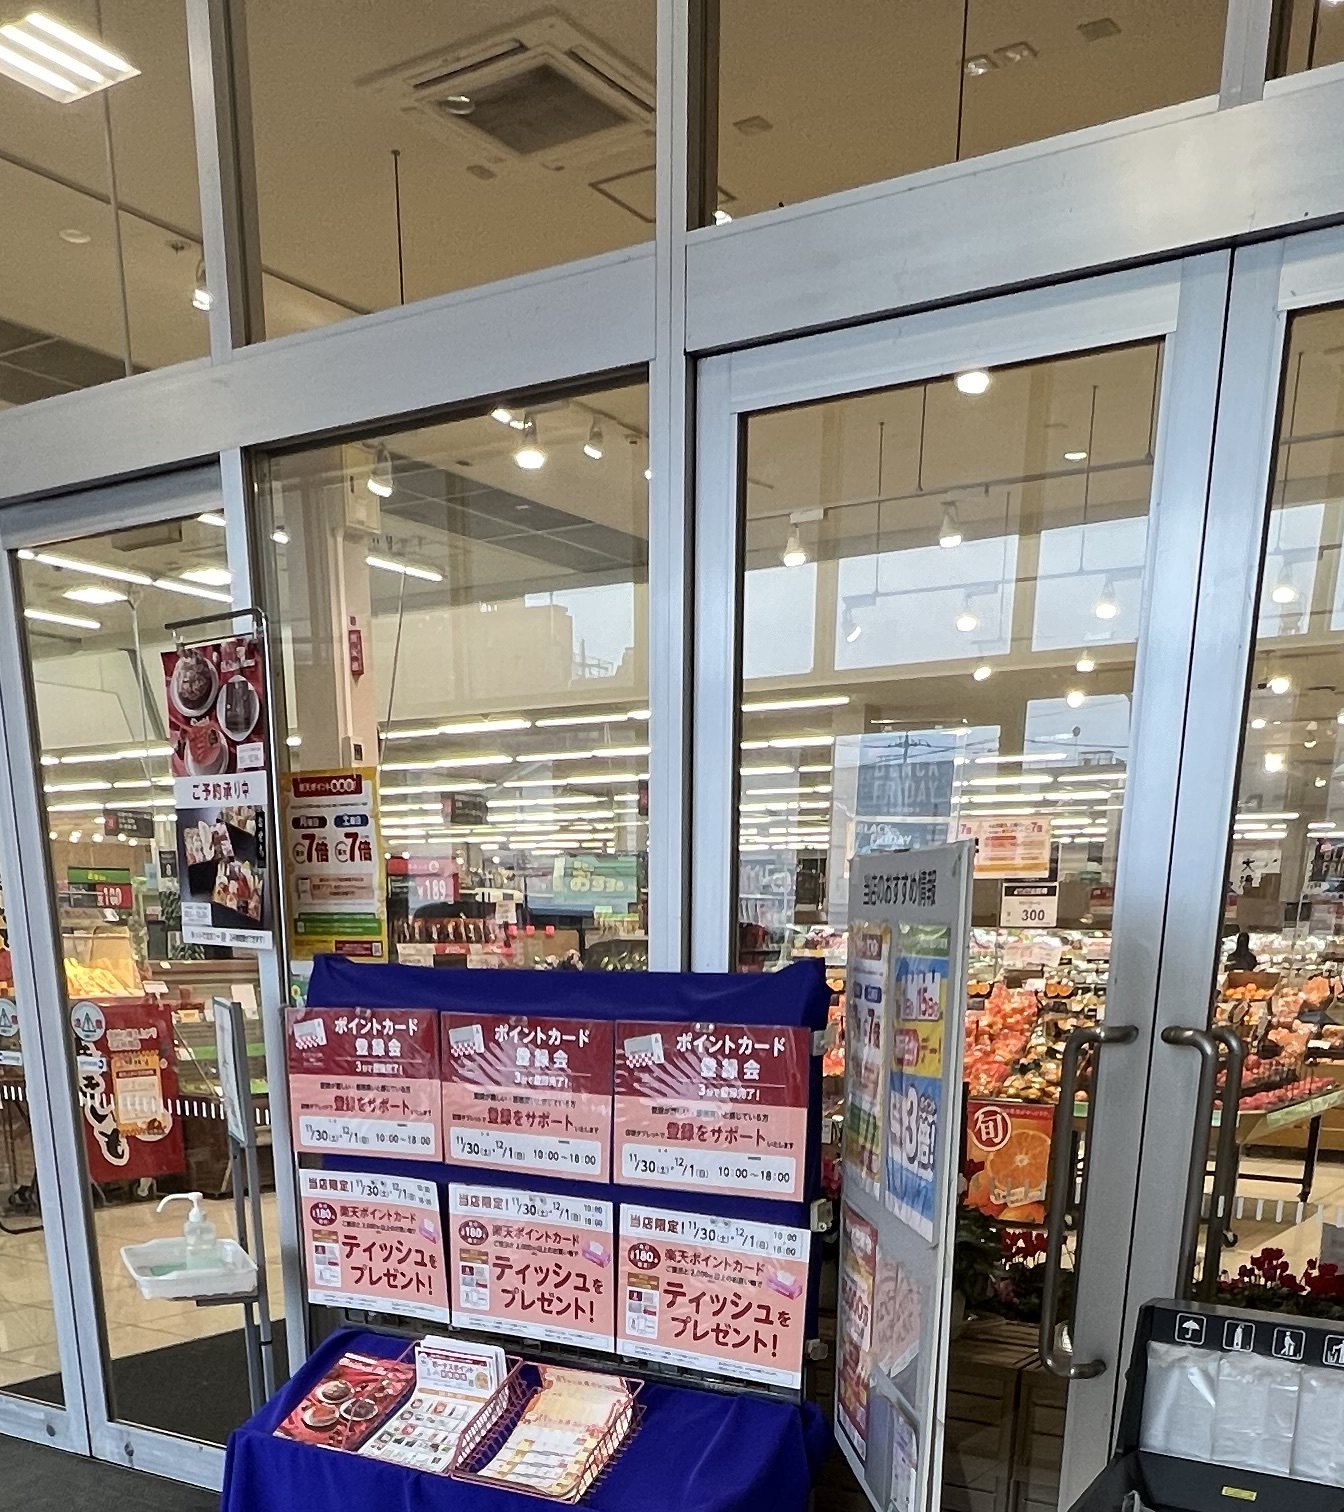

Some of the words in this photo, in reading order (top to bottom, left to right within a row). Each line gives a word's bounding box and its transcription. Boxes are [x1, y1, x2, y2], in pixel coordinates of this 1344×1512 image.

[192, 780, 251, 800] ご予約承り中
[1021, 909, 1045, 922] 300
[335, 1016, 419, 1037] ポイントカード
[495, 1024, 590, 1048] ポイントカード
[676, 1032, 786, 1058] ポイントカード
[334, 1095, 410, 1116] 登録をサポート
[487, 1106, 574, 1132] 登録をサポート
[666, 1121, 766, 1147] 登録をサポート
[974, 1113, 1002, 1144] 旬
[341, 1233, 438, 1270] ティッシュを
[664, 1248, 767, 1278] 楽天ポイントカード
[350, 1263, 434, 1296] プレゼント!
[492, 1254, 604, 1296] ティッシュを
[500, 1286, 596, 1324] プレゼント!
[662, 1280, 793, 1329] ティッシュを
[670, 1315, 779, 1359] プレゼント!
